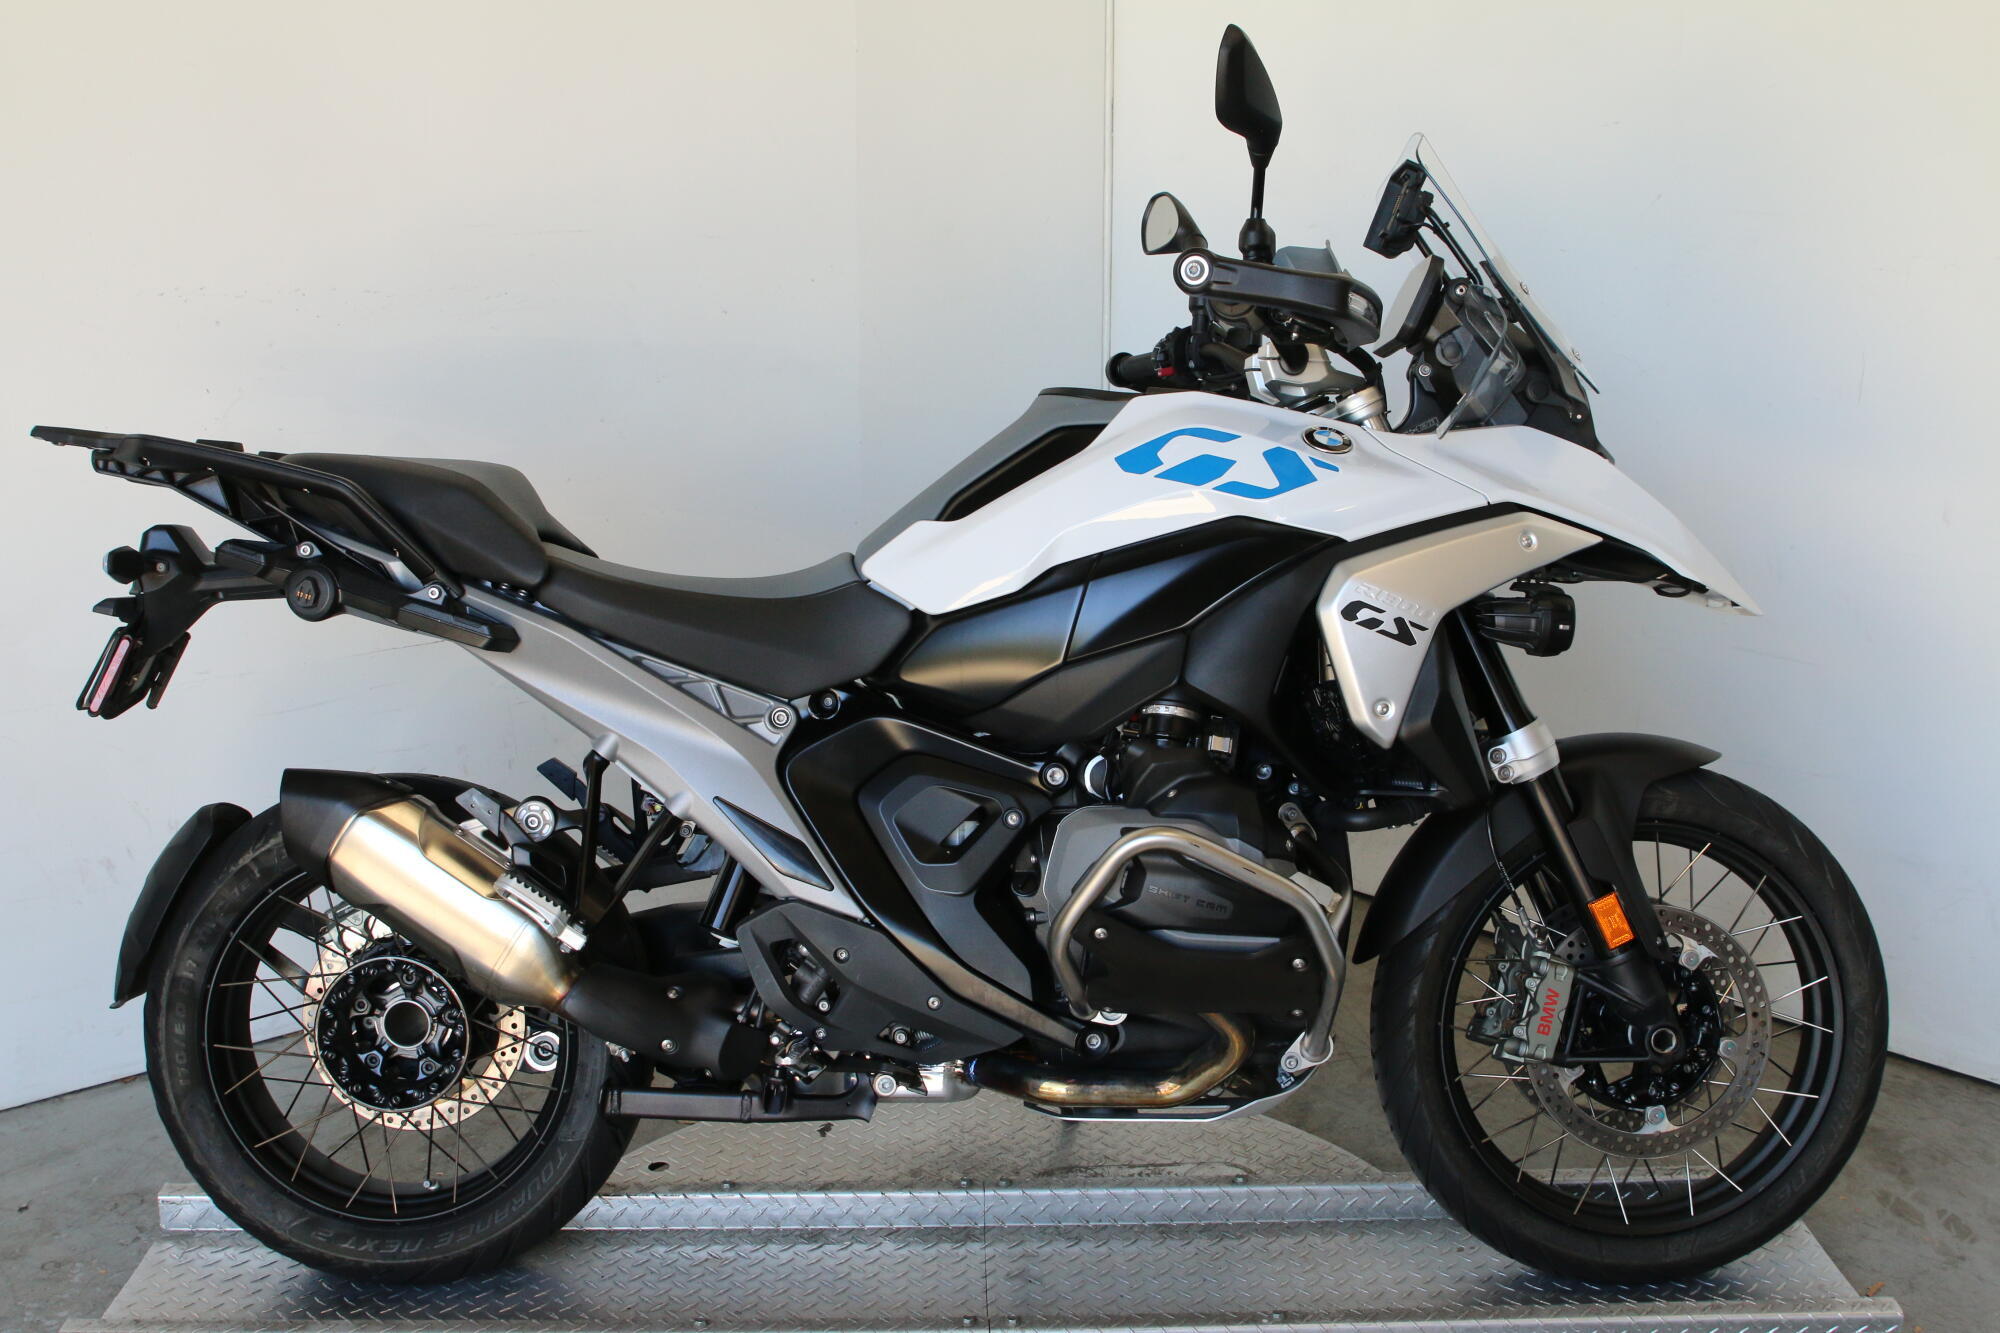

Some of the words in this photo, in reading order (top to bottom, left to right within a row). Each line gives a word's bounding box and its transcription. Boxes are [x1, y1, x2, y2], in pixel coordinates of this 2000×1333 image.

[1114, 427, 1339, 499] GS
[1341, 600, 1429, 646] GS
[1536, 987, 1560, 1036] BMW
[434, 1149, 568, 1243] TOURANCE
[341, 1238, 425, 1253] NEXT
